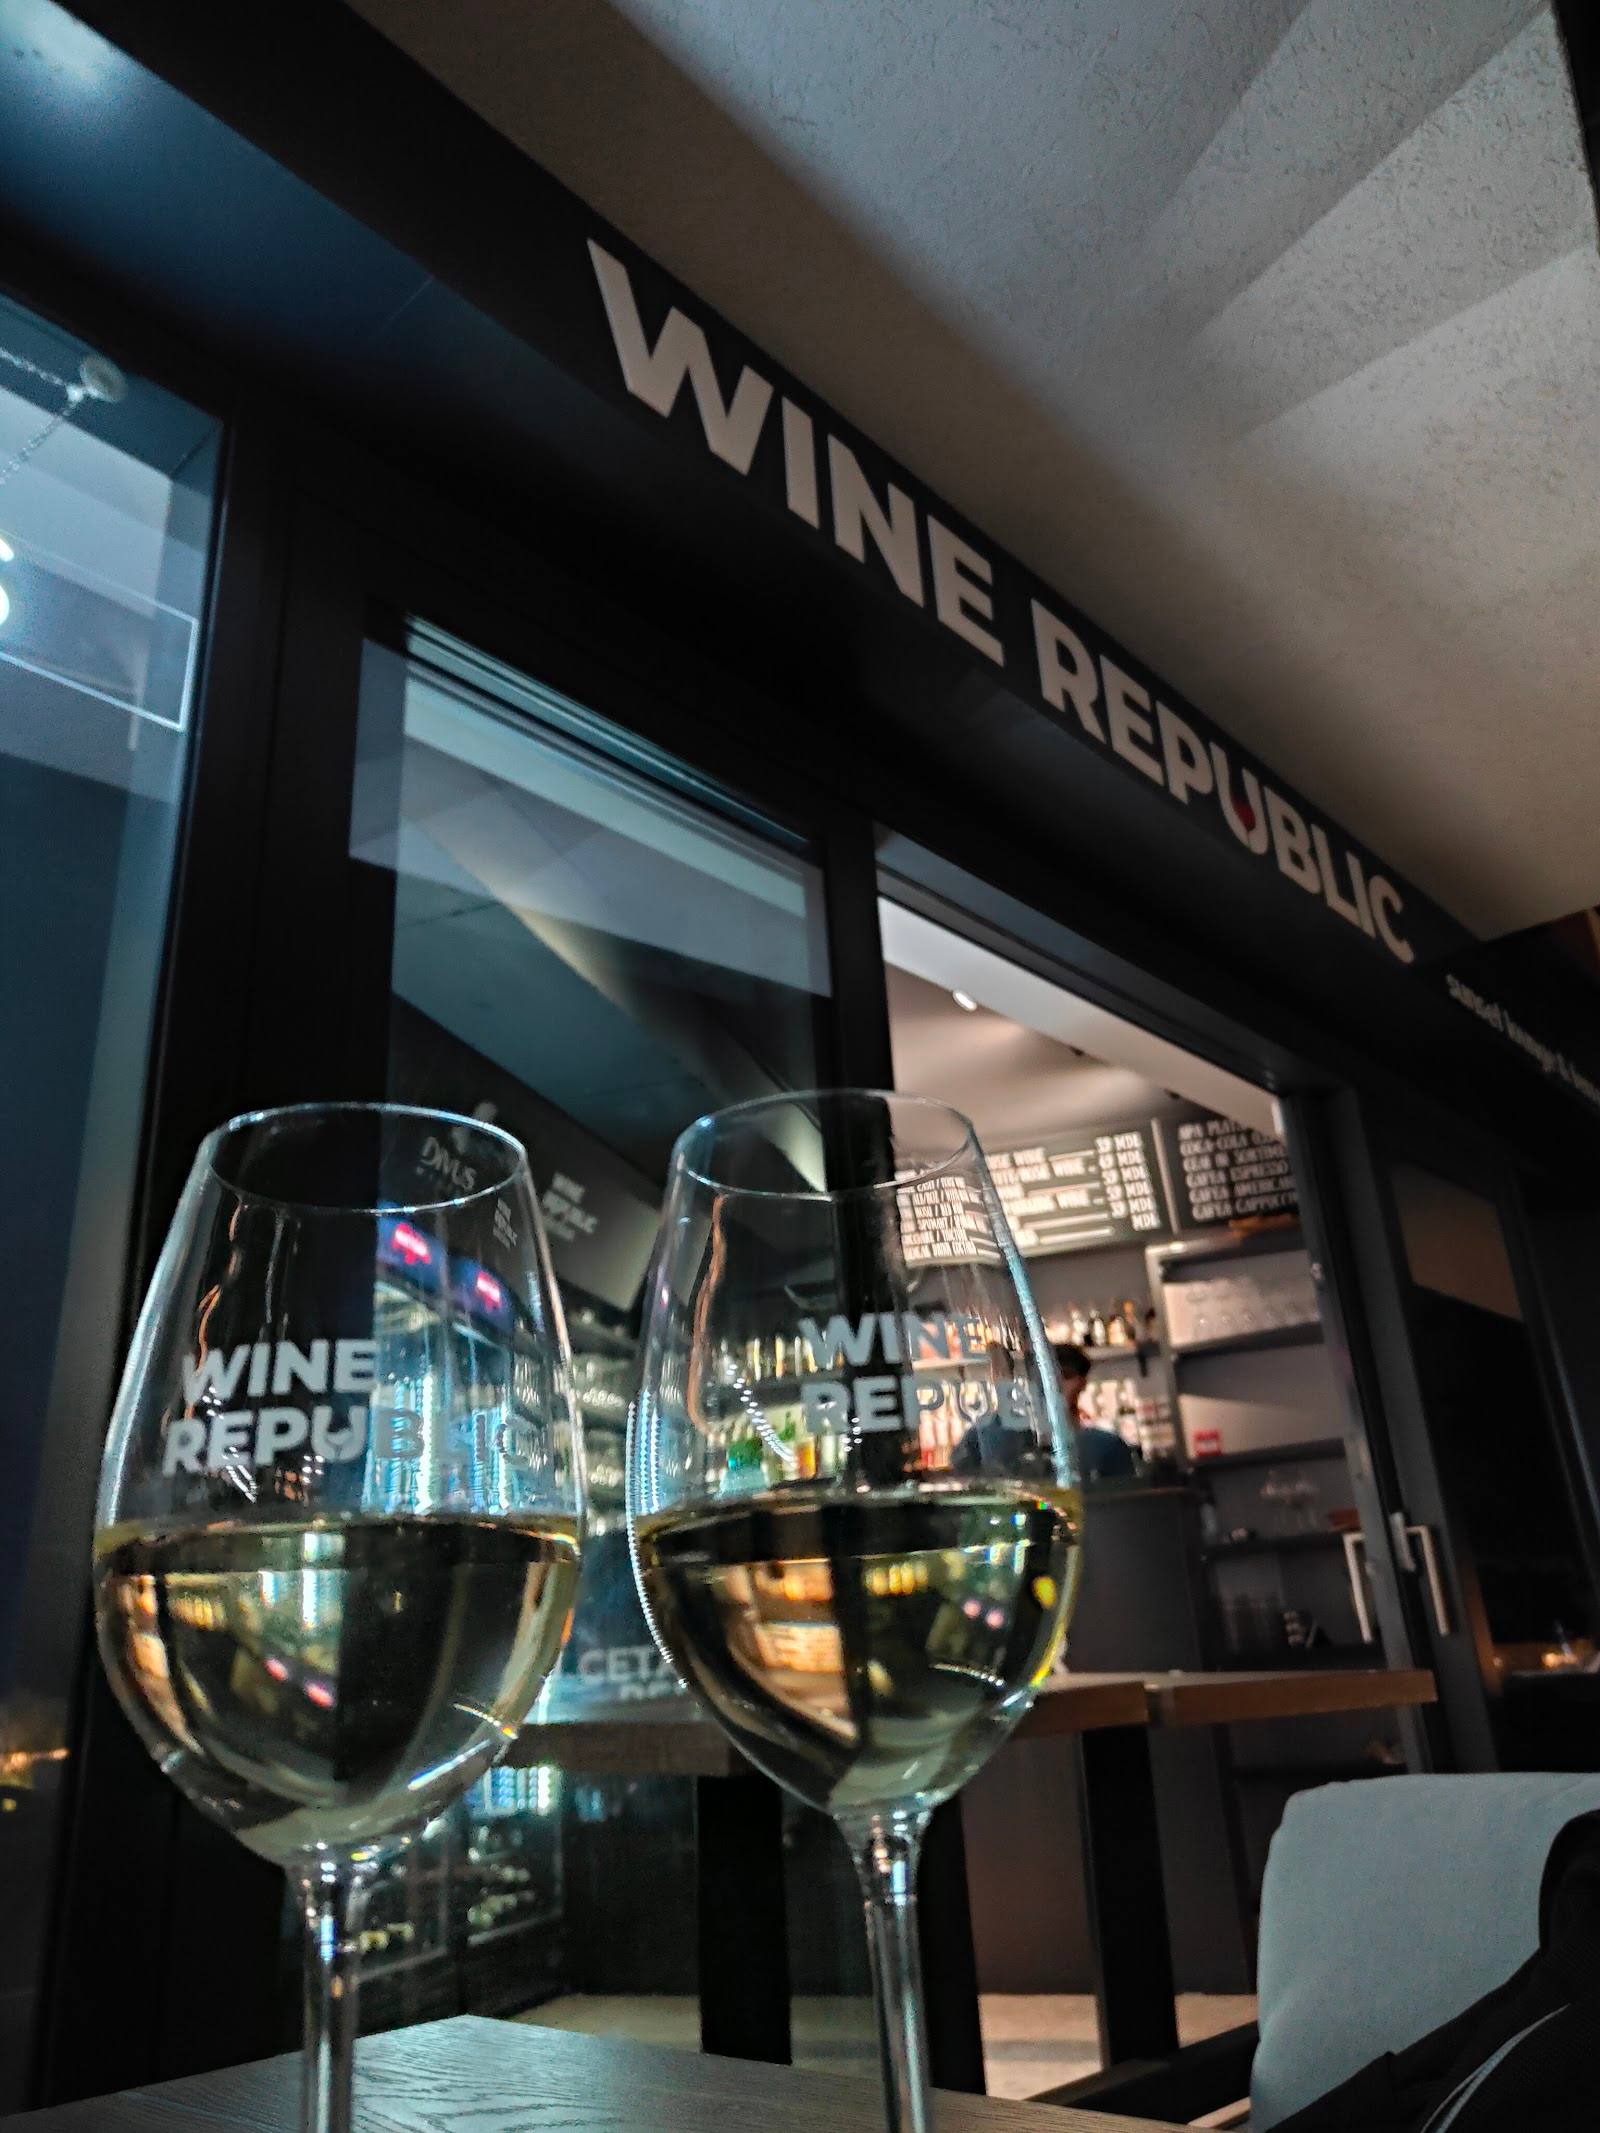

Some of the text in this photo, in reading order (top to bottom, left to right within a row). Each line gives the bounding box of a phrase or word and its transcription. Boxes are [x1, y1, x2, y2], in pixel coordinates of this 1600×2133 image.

[586, 238, 1415, 964] WINE REPUBLIC
[182, 1339, 378, 1404] WINE
[798, 1311, 987, 1367] WINE
[800, 1373, 1052, 1437] REPUB
[162, 1403, 540, 1476] REPUBIC
